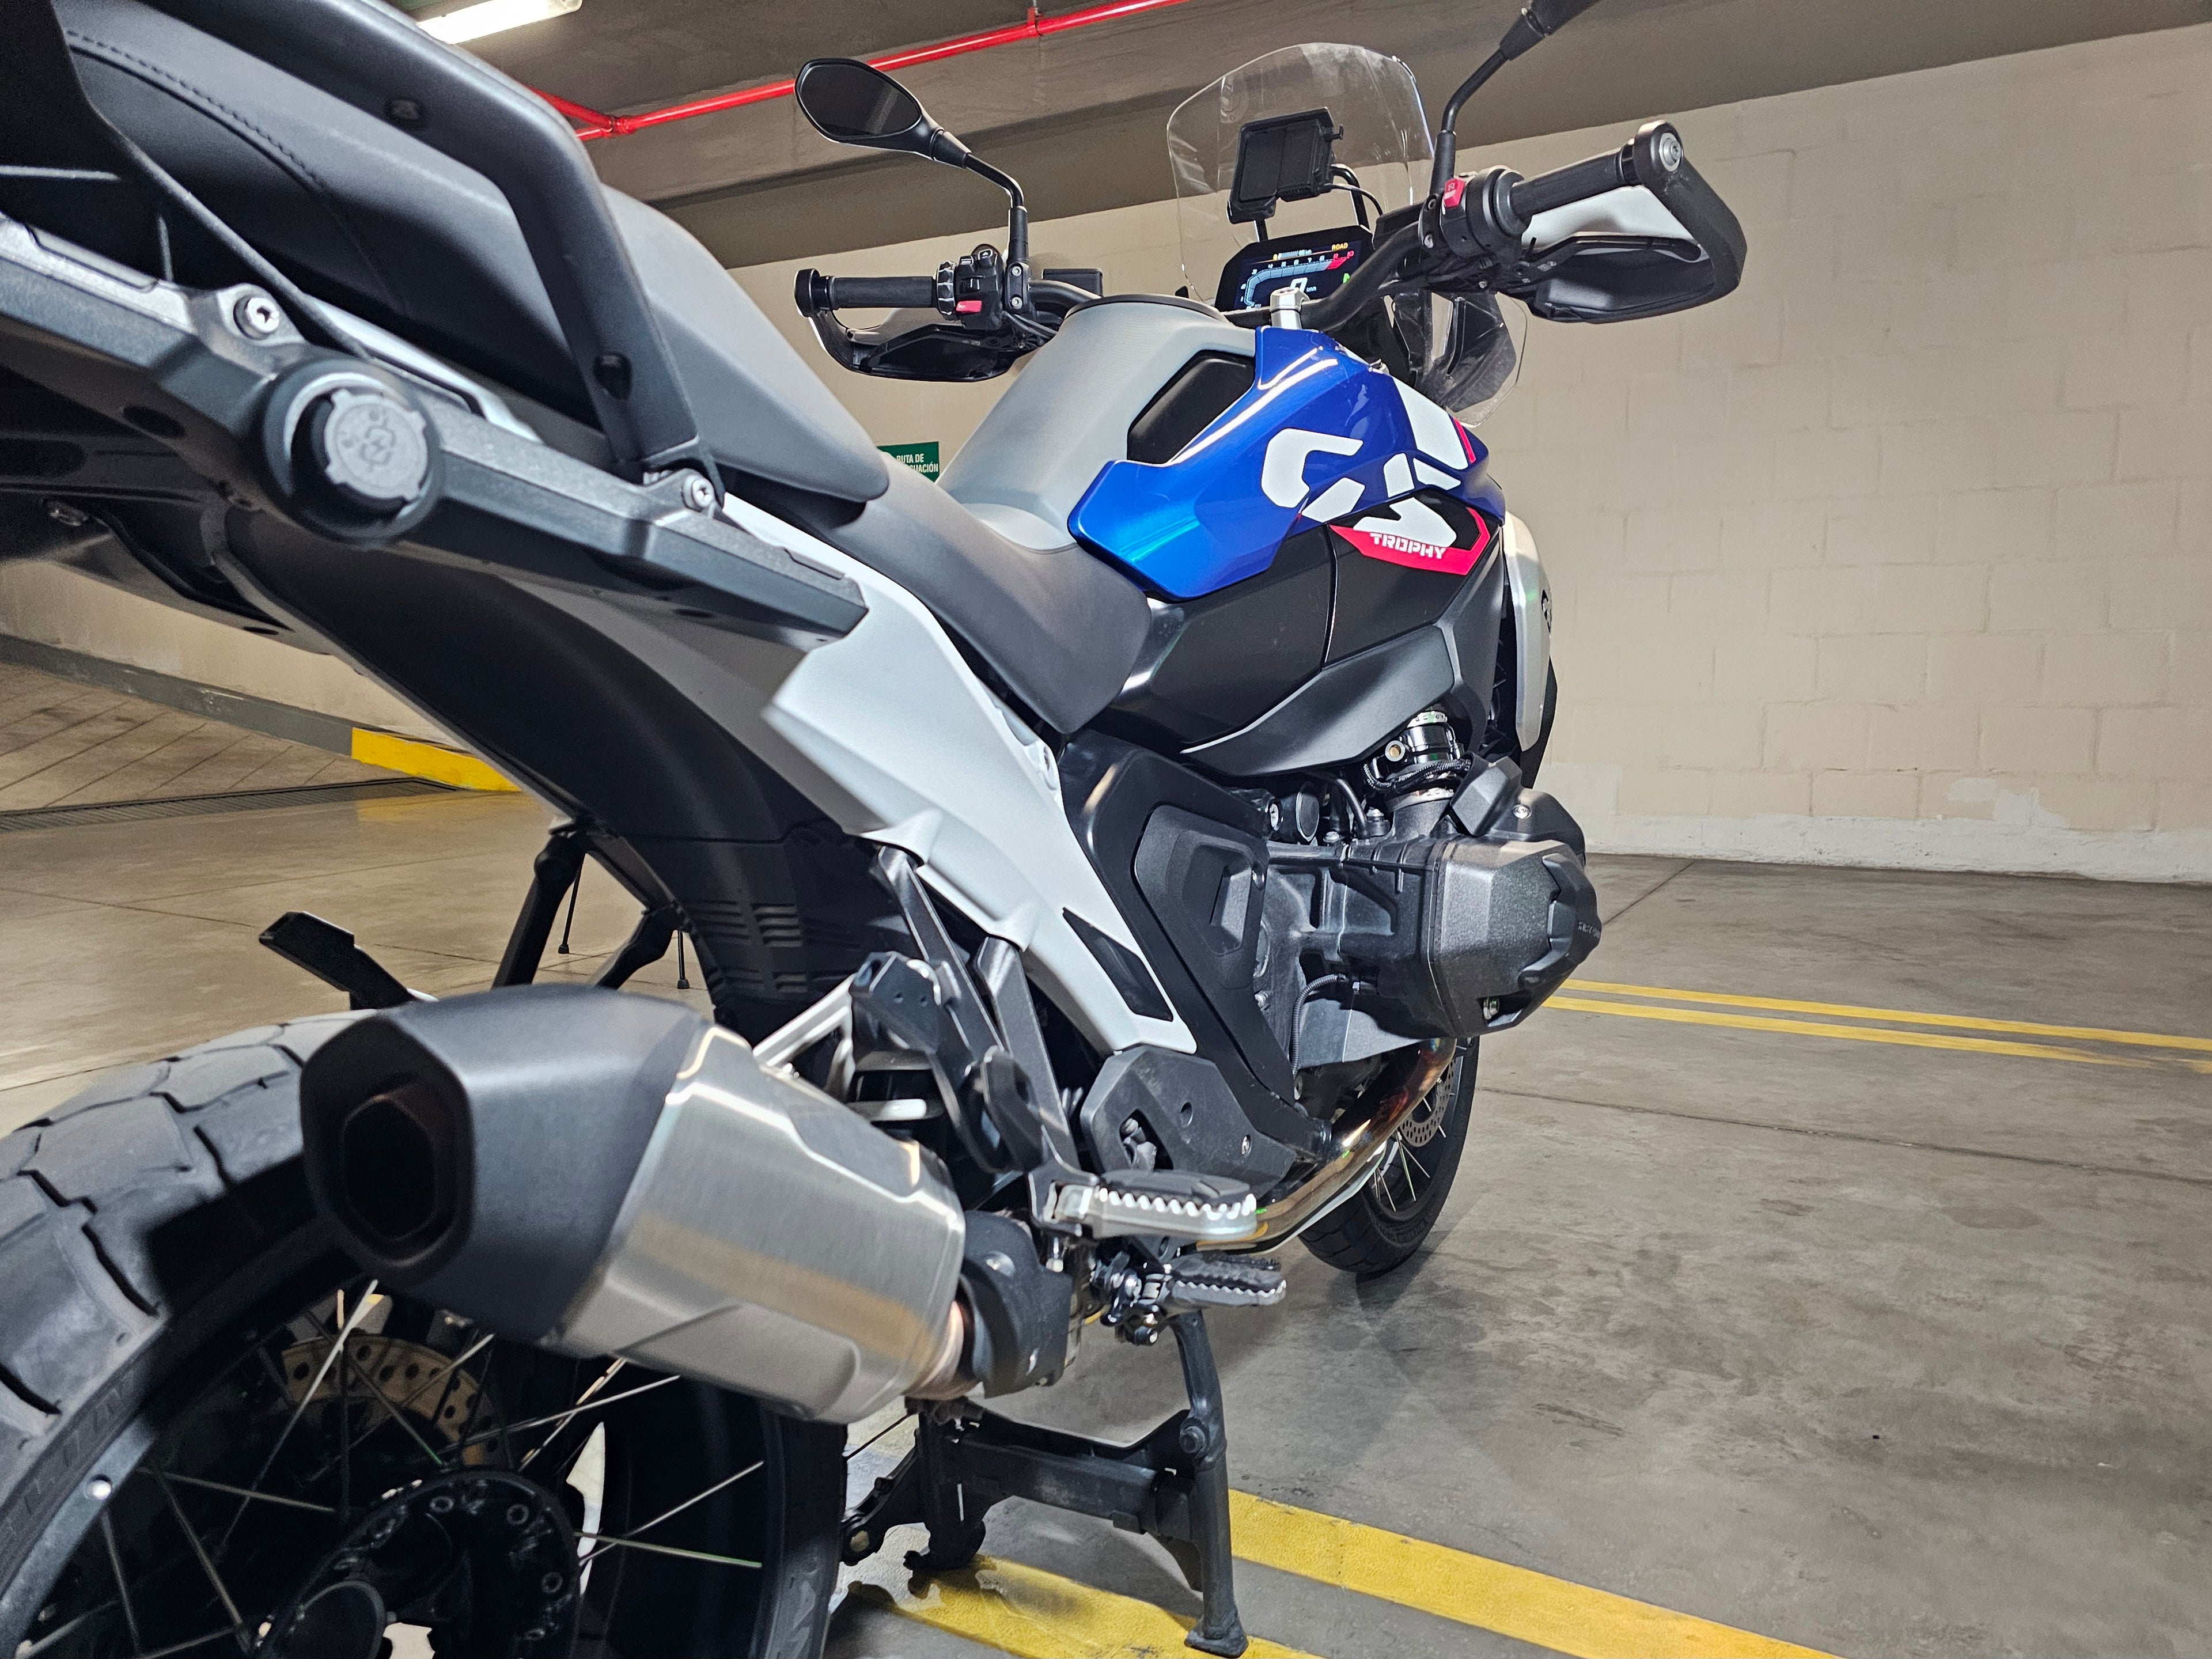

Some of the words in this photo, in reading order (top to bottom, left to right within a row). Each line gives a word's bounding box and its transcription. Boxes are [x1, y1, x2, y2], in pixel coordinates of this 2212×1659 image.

[1332, 243, 1349, 251] ROAD
[915, 453, 925, 463] DE
[1370, 532, 1447, 559] TROPHY
